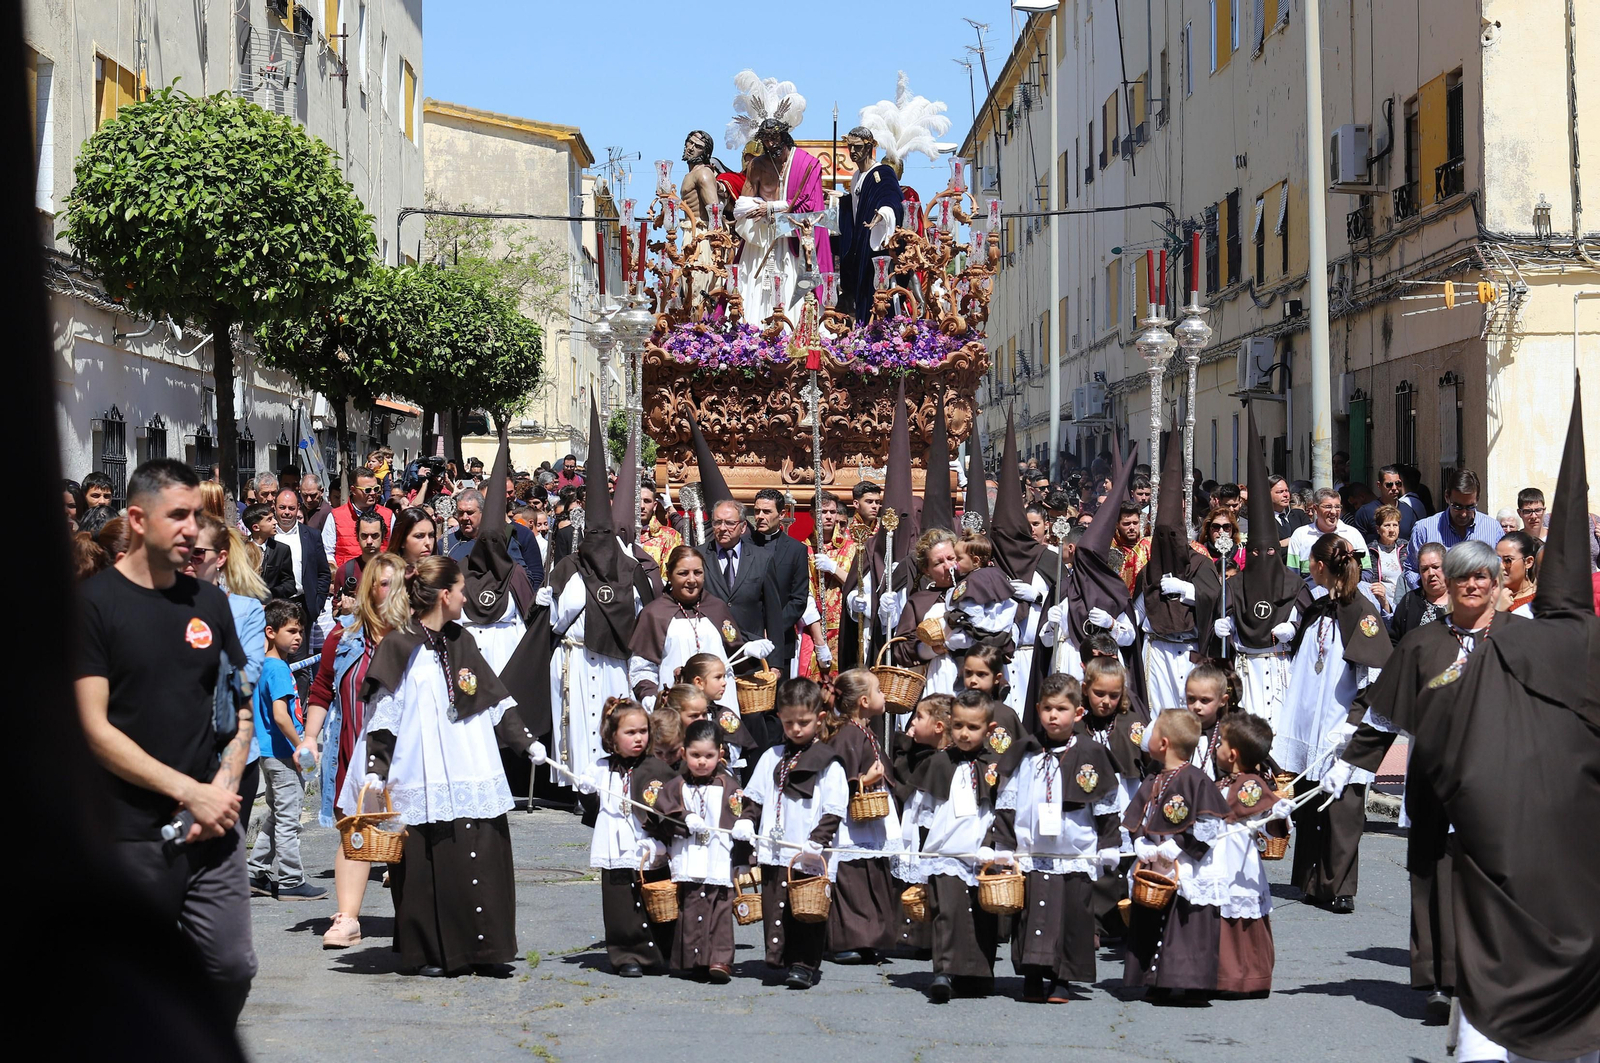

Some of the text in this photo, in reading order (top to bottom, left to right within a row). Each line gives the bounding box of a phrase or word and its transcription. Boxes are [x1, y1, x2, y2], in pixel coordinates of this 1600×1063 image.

[483, 592, 493, 604] T
[600, 589, 610, 601] T
[1258, 603, 1269, 617] T
